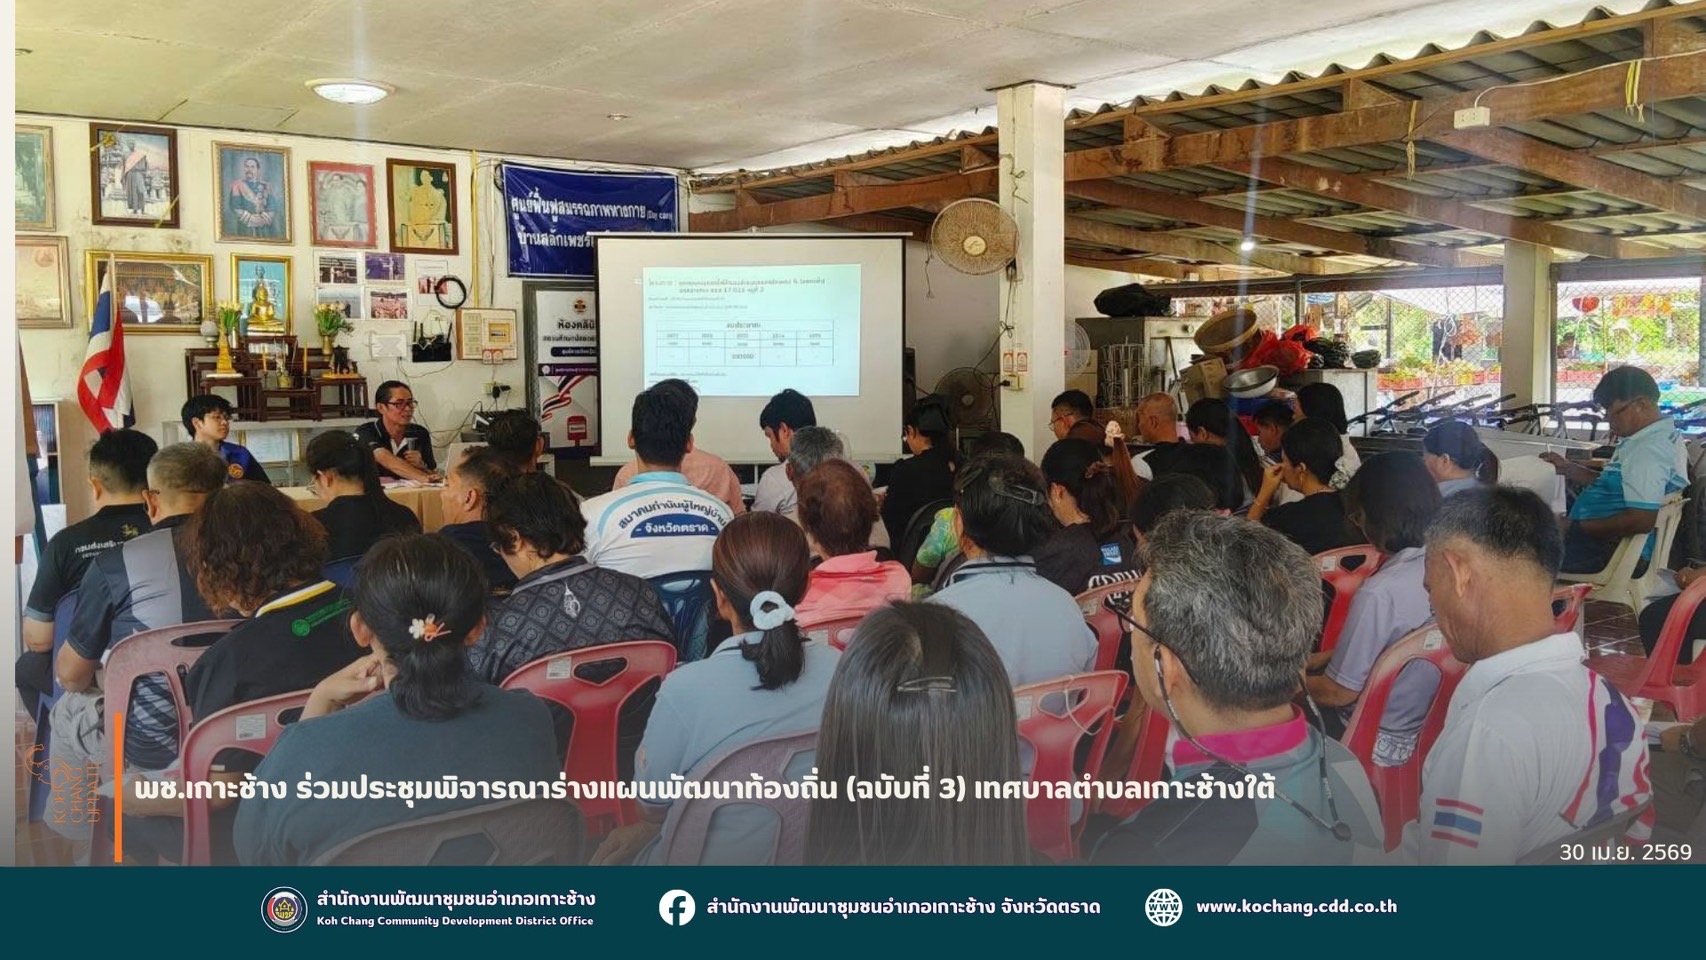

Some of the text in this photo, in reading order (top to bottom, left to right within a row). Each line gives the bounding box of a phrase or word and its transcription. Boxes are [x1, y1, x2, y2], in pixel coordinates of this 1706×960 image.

[618, 500, 727, 530] สมาคมกำนันผู้ใหญ่บ้าน
[645, 522, 709, 534] จังหวัดตราด
